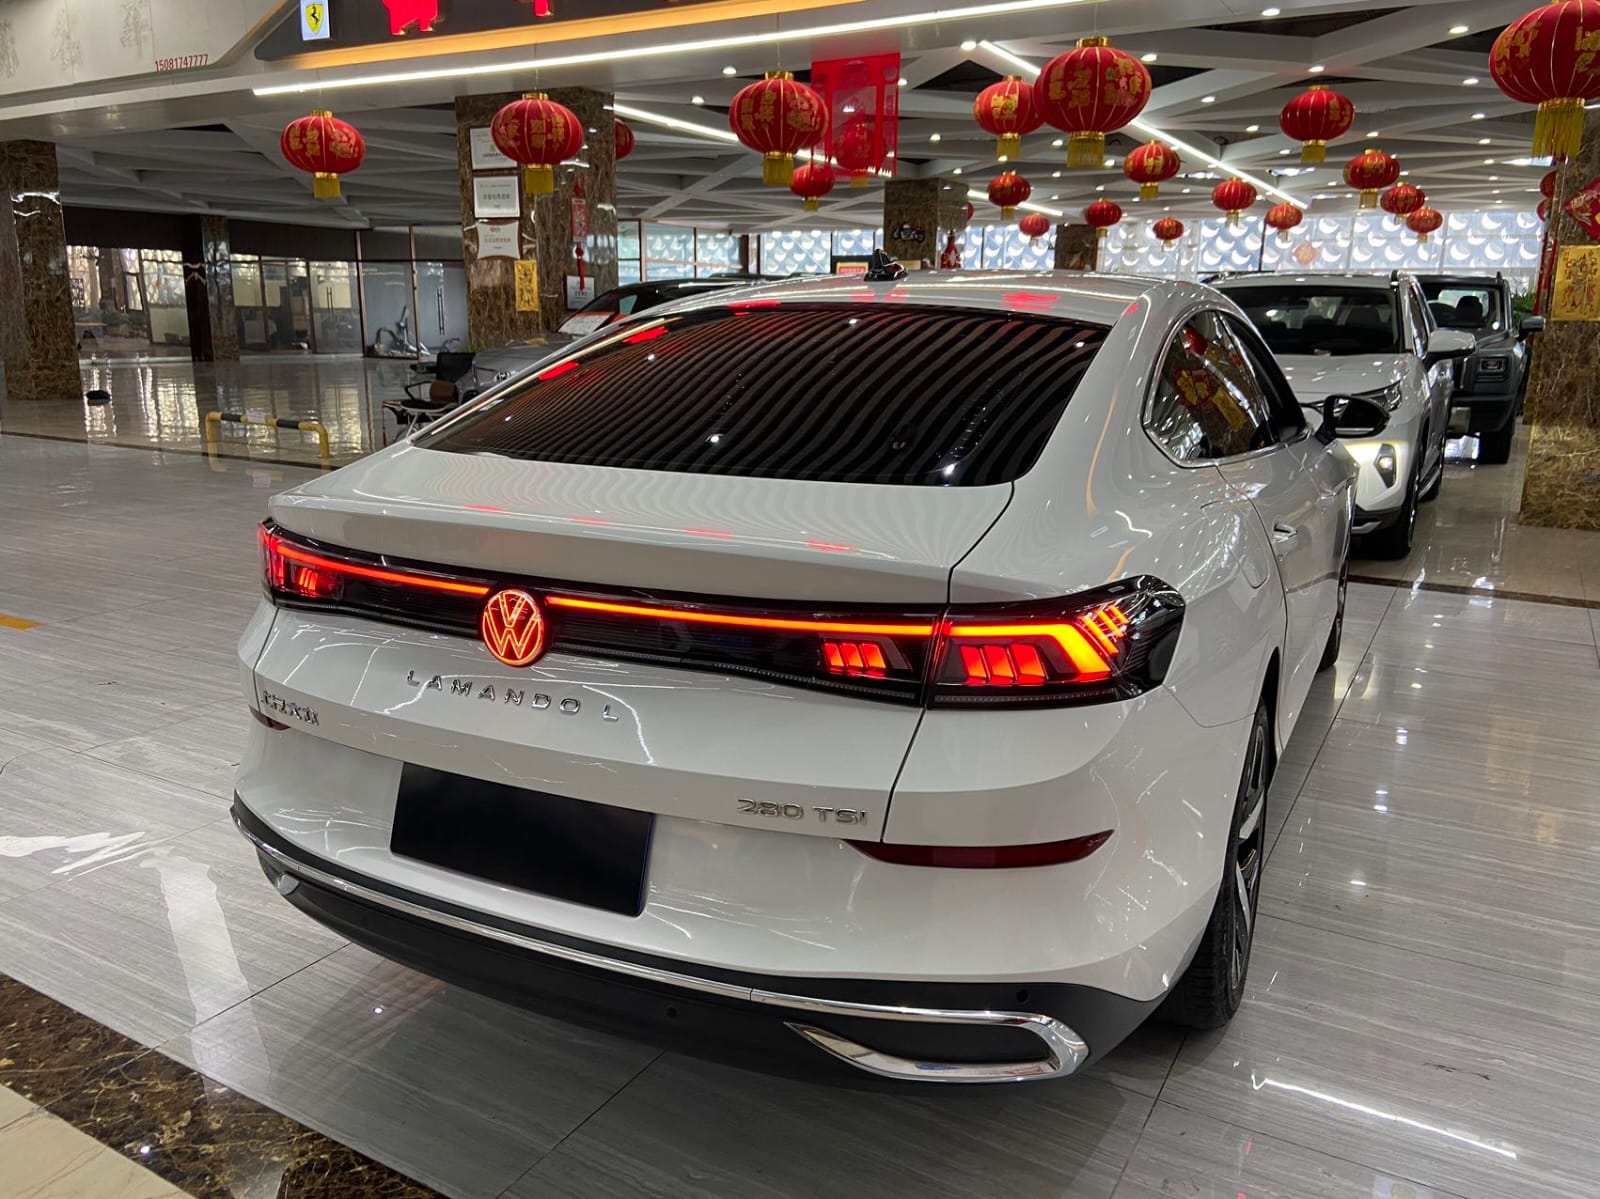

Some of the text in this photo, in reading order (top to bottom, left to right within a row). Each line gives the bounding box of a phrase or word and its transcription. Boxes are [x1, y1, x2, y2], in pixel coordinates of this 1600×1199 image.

[154, 53, 209, 72] 15081747777
[481, 589, 543, 666] VW
[406, 670, 619, 722] LAMANDO L
[737, 798, 867, 826] 280 TSI
